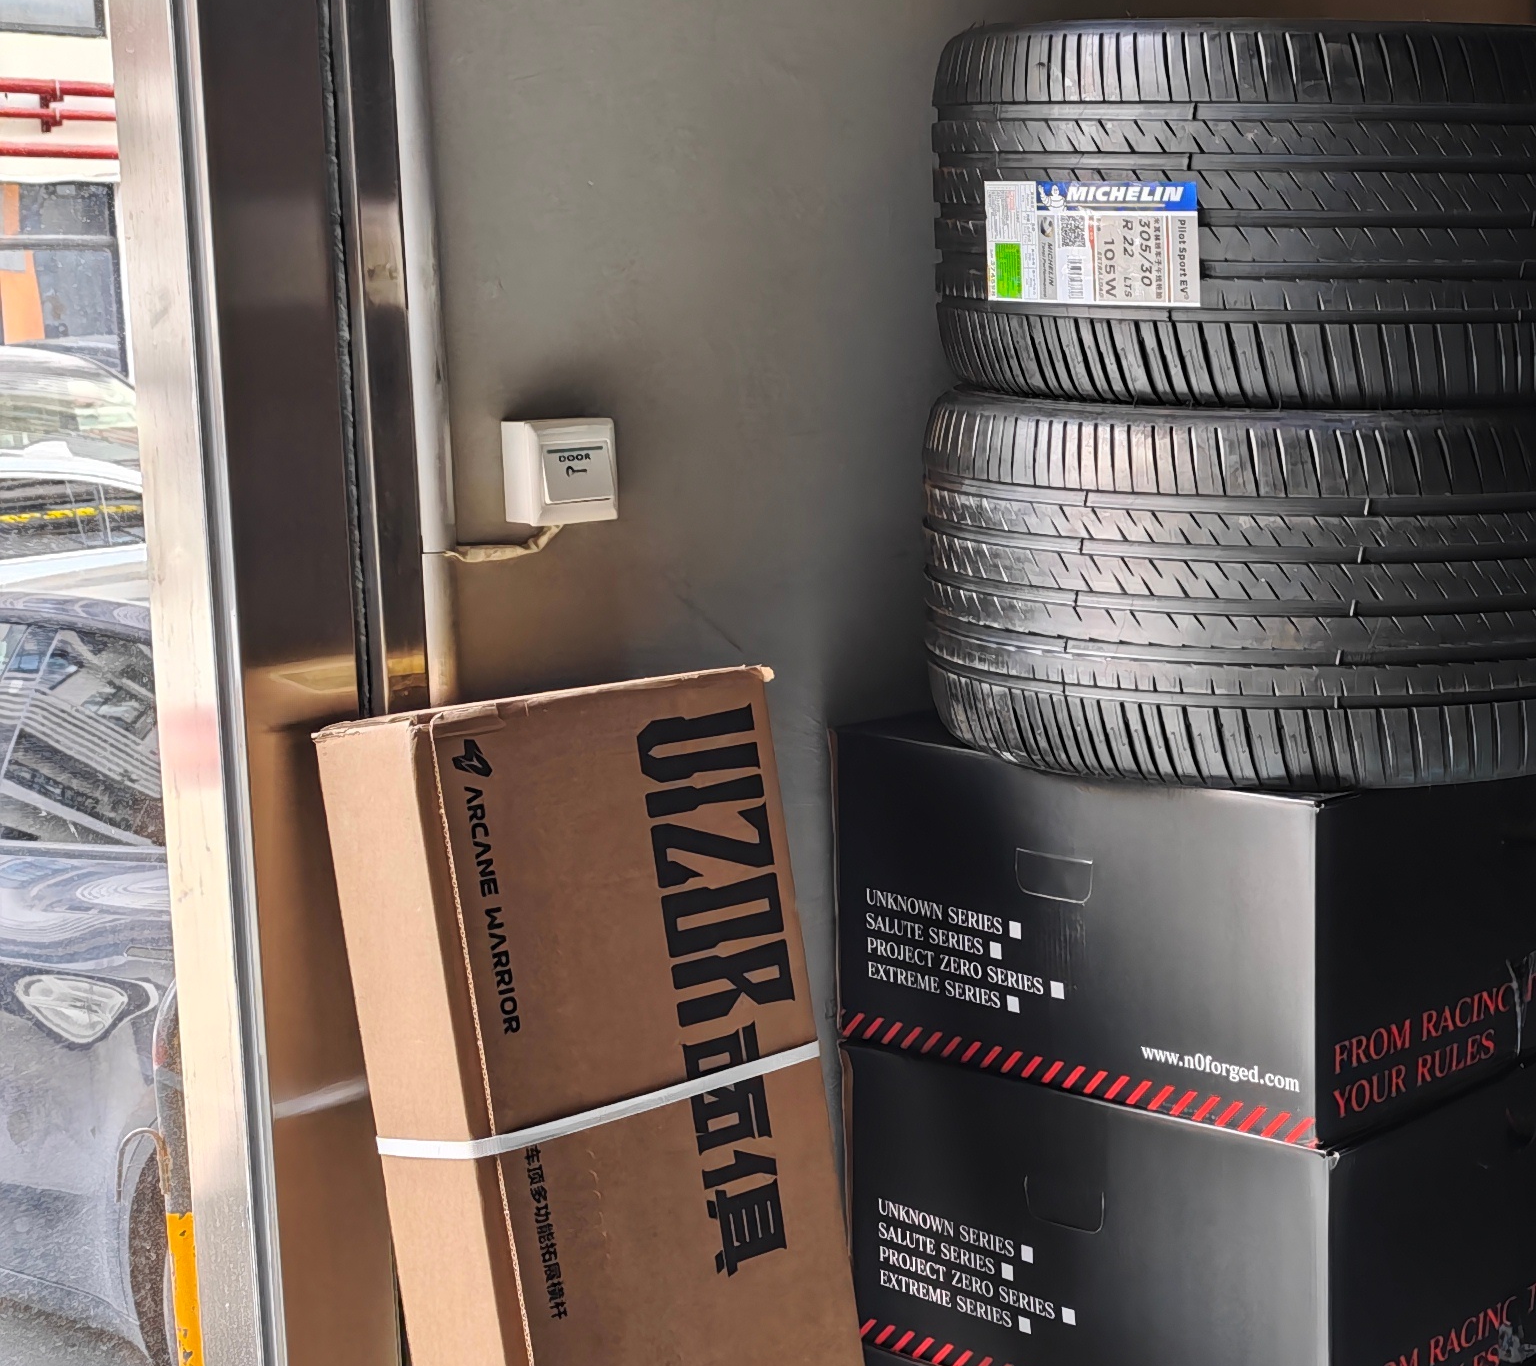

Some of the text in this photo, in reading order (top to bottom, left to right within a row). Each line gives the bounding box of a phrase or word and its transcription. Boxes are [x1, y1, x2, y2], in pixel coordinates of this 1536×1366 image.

[1066, 186, 1184, 202] MICHELIN
[1138, 218, 1153, 287] 305/30
[1177, 218, 1187, 245] Pilot
[1103, 238, 1117, 298] 105W
[1123, 276, 1132, 298] LTS
[1177, 248, 1187, 277] Sport
[558, 452, 591, 463] DOOR
[464, 785, 521, 1035] ARCANE WARRIOR
[865, 887, 1003, 935] UNKNOWN SERIES
[865, 912, 984, 956] SALUTE SERIES
[866, 936, 1044, 995] PROJECT ZERO SERIES
[867, 961, 1001, 1010] EXTREME SERIES
[1141, 1045, 1300, 1093] www.n0forged.com
[1333, 1018, 1411, 1075] FROM
[1333, 1029, 1495, 1119] YOUR RULES
[878, 1197, 1015, 1257] UNKNOWN SERIES
[878, 1221, 995, 1275] SALUTE SERIES
[879, 1245, 1056, 1320] PROJECT ZERO SERIES
[879, 1269, 1013, 1329] EXTREME SERIES
